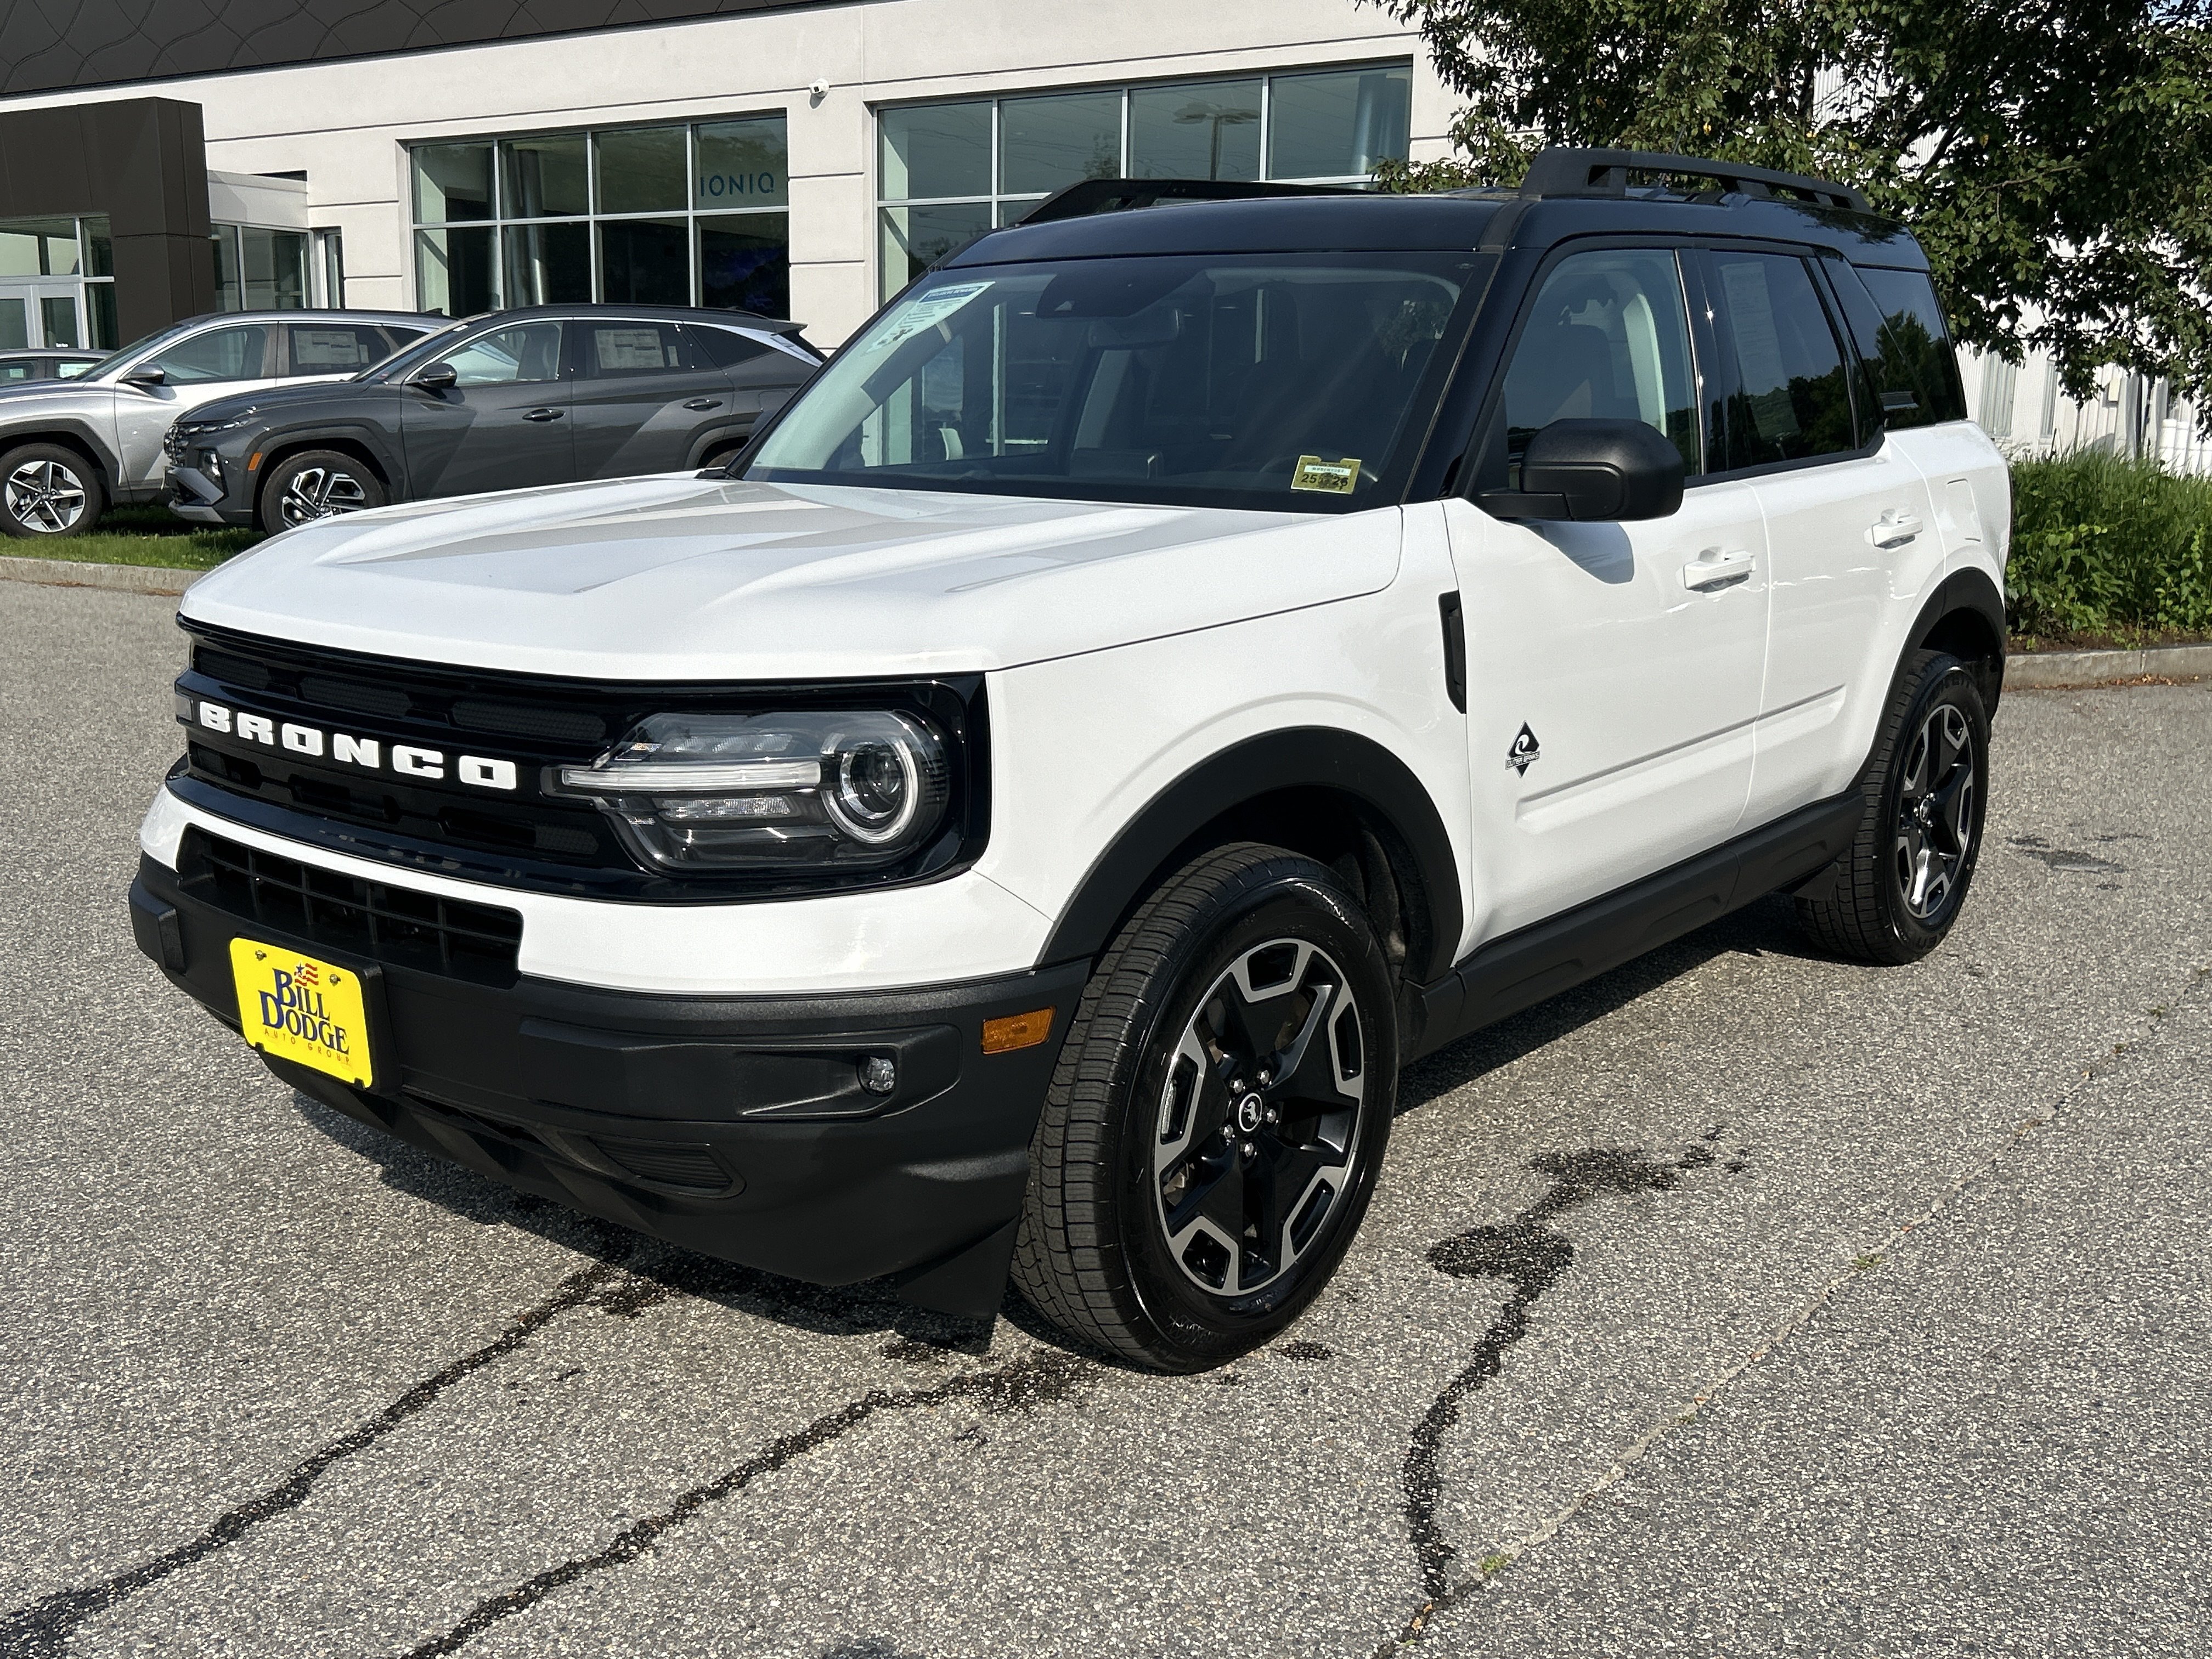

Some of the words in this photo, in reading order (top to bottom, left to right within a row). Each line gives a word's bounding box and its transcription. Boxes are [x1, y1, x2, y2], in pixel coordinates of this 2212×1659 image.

[700, 172, 775, 196] IONIQ
[1301, 473, 1318, 483] 25
[199, 701, 517, 790] BRONCO
[273, 968, 330, 1020] BILL
[258, 990, 350, 1055] DODGE
[264, 1029, 296, 1045] AUTO
[308, 1043, 350, 1064] GROUP
